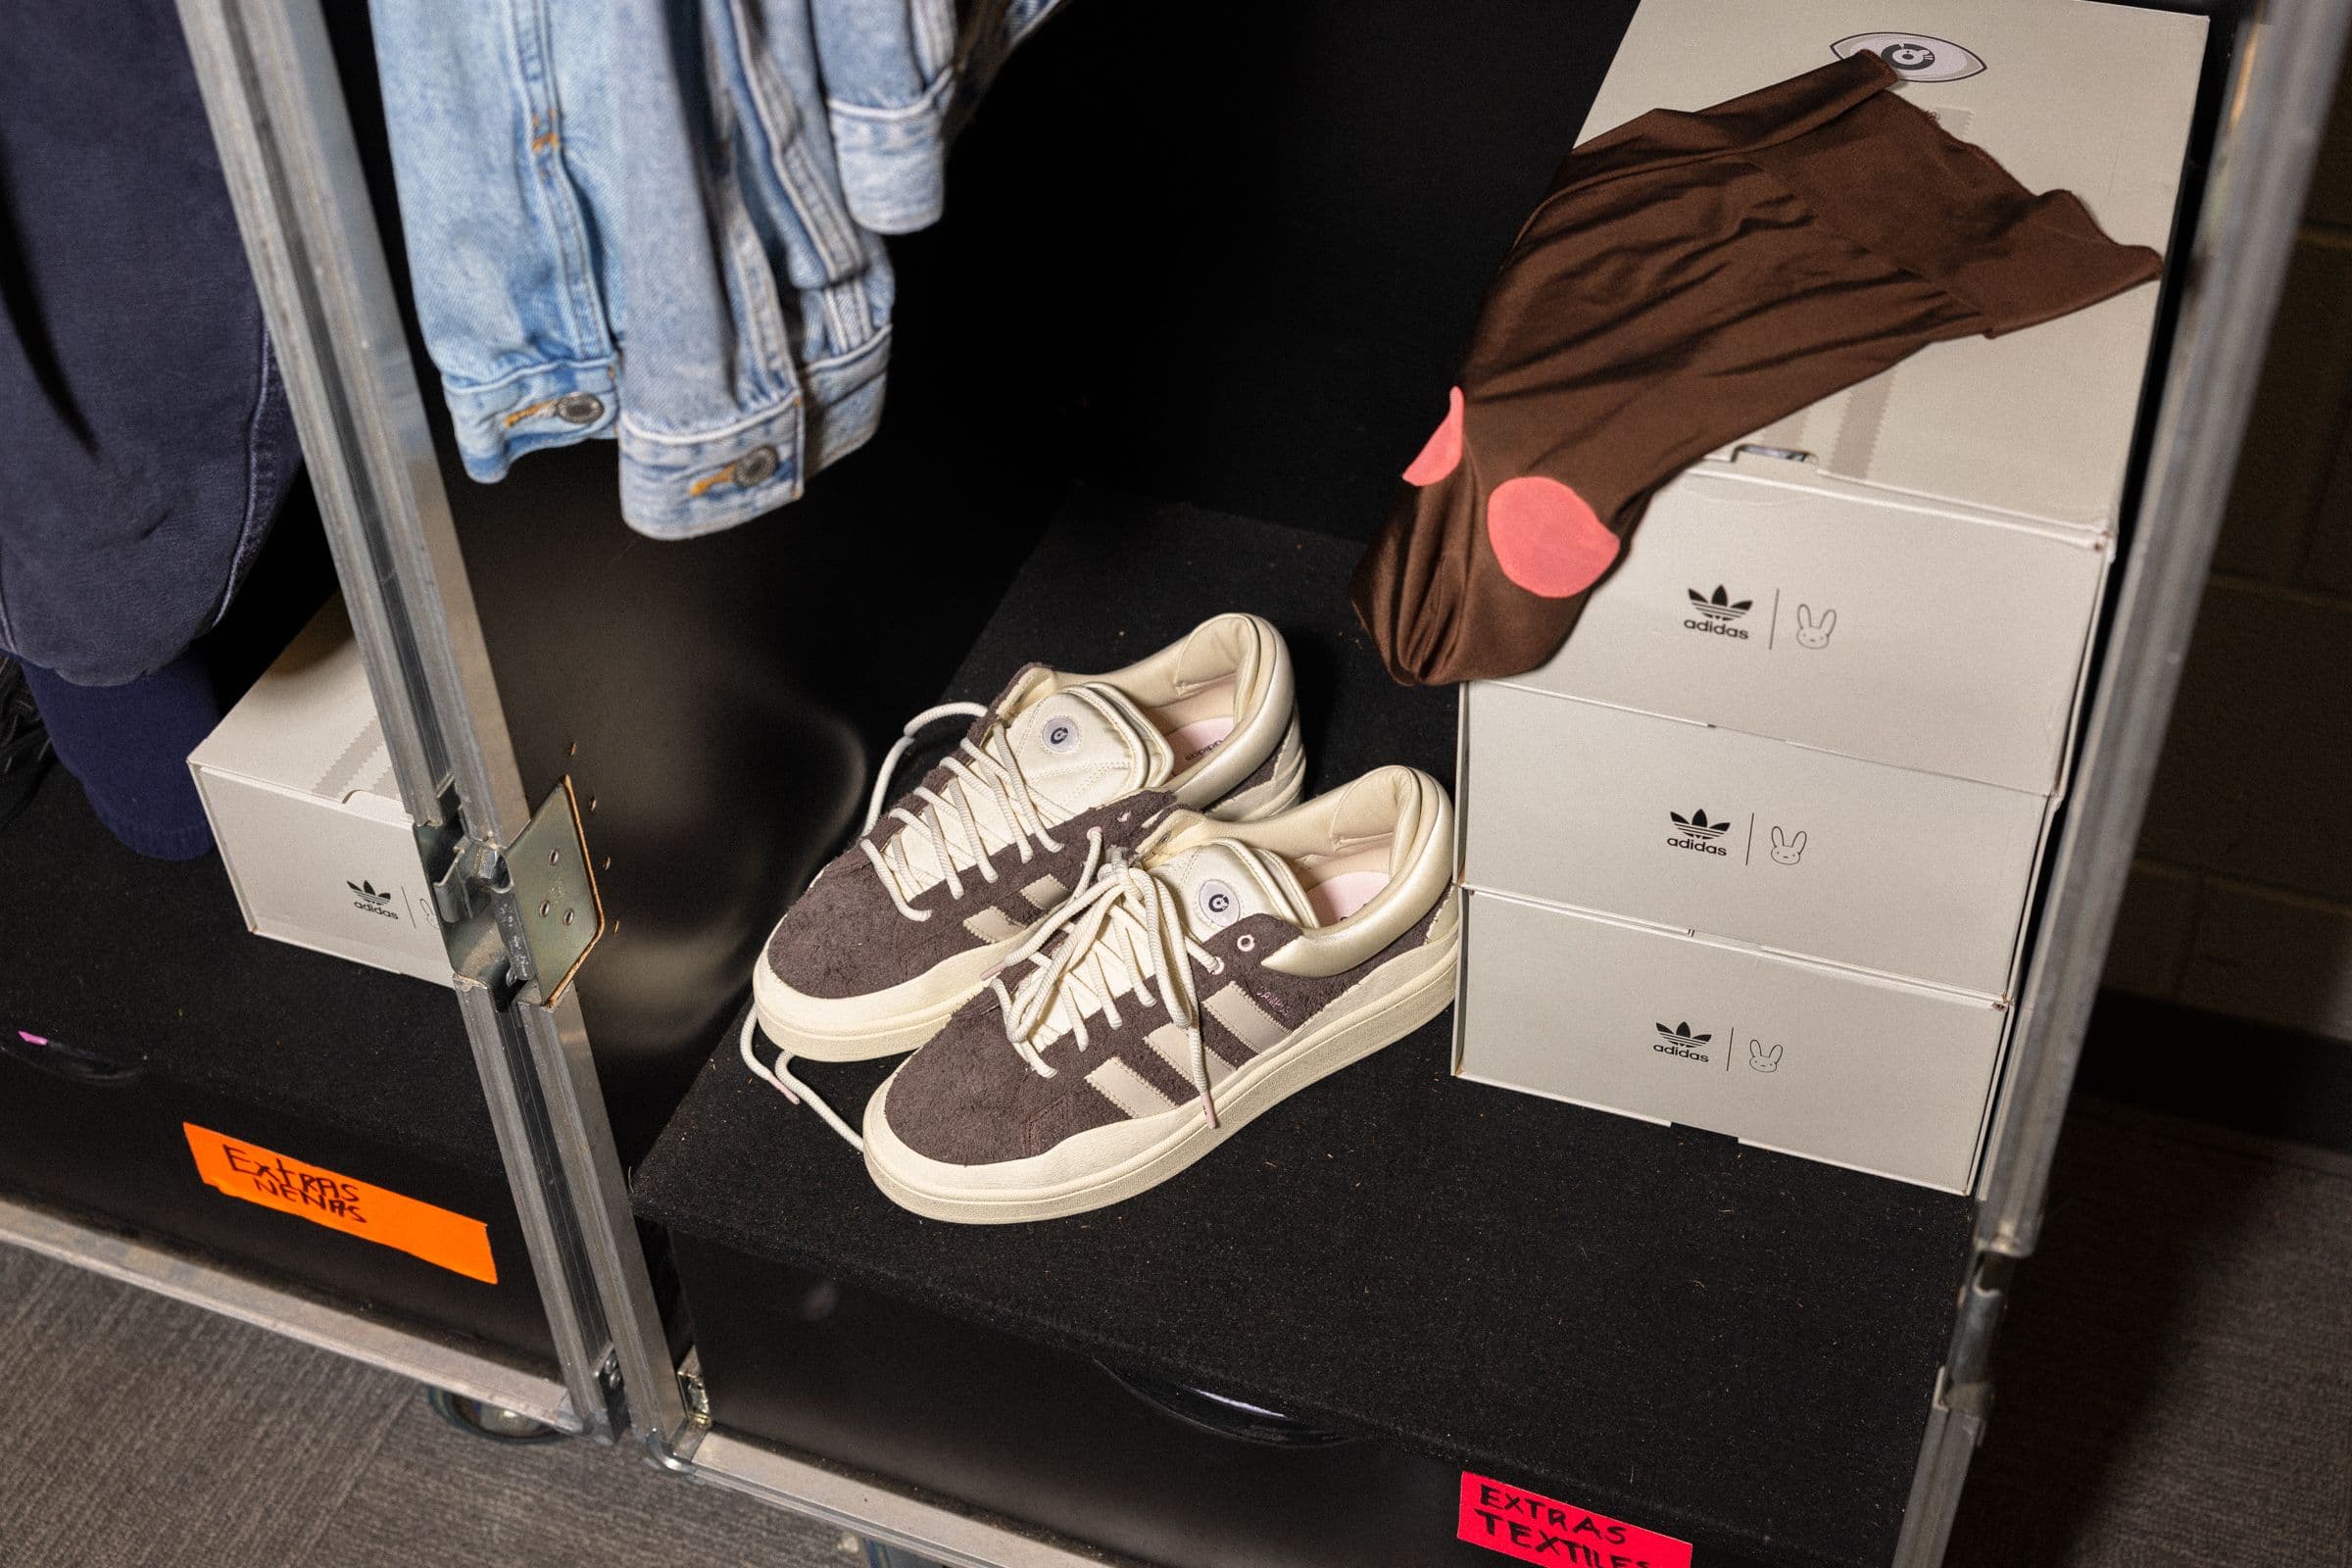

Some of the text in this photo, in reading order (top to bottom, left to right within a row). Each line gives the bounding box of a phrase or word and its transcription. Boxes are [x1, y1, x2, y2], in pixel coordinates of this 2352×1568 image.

[1683, 618, 1749, 640] adidas
[1666, 837, 1728, 857] adidas
[354, 901, 399, 920] adidas
[1652, 1044, 1709, 1062] adidas
[1480, 1483, 1628, 1545] EXTRAS
